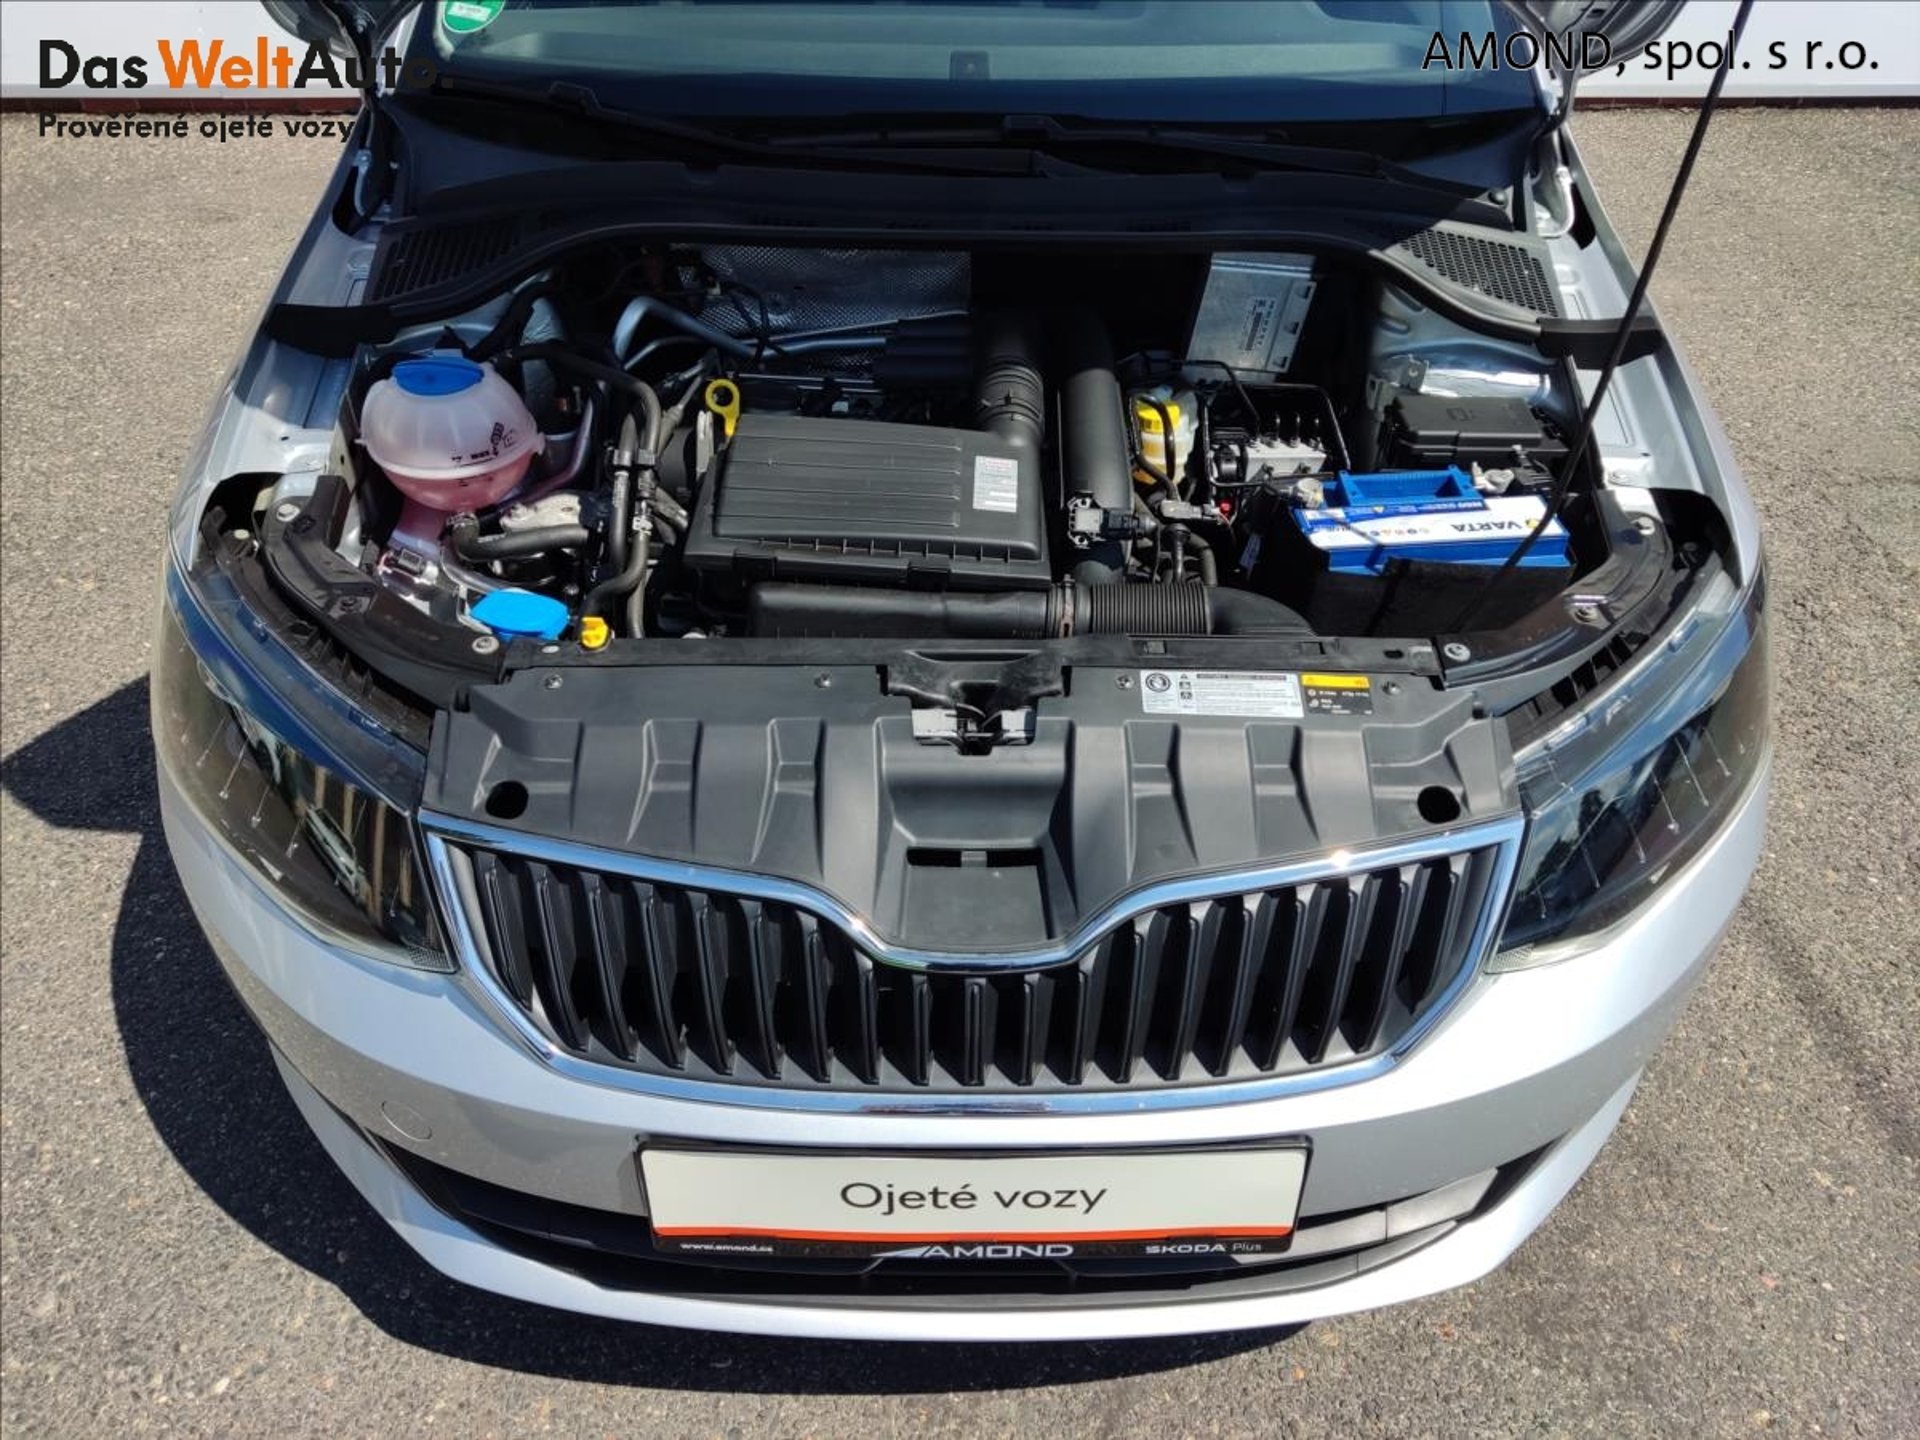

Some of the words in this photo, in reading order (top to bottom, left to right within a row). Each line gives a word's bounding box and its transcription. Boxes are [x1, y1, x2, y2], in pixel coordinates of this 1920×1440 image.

[1450, 520, 1523, 532] VARTA
[840, 1182, 978, 1215] Ojeté
[993, 1188, 1107, 1214] vozy
[923, 1244, 1073, 1258] AMOND
[1232, 1242, 1262, 1252] Plus
